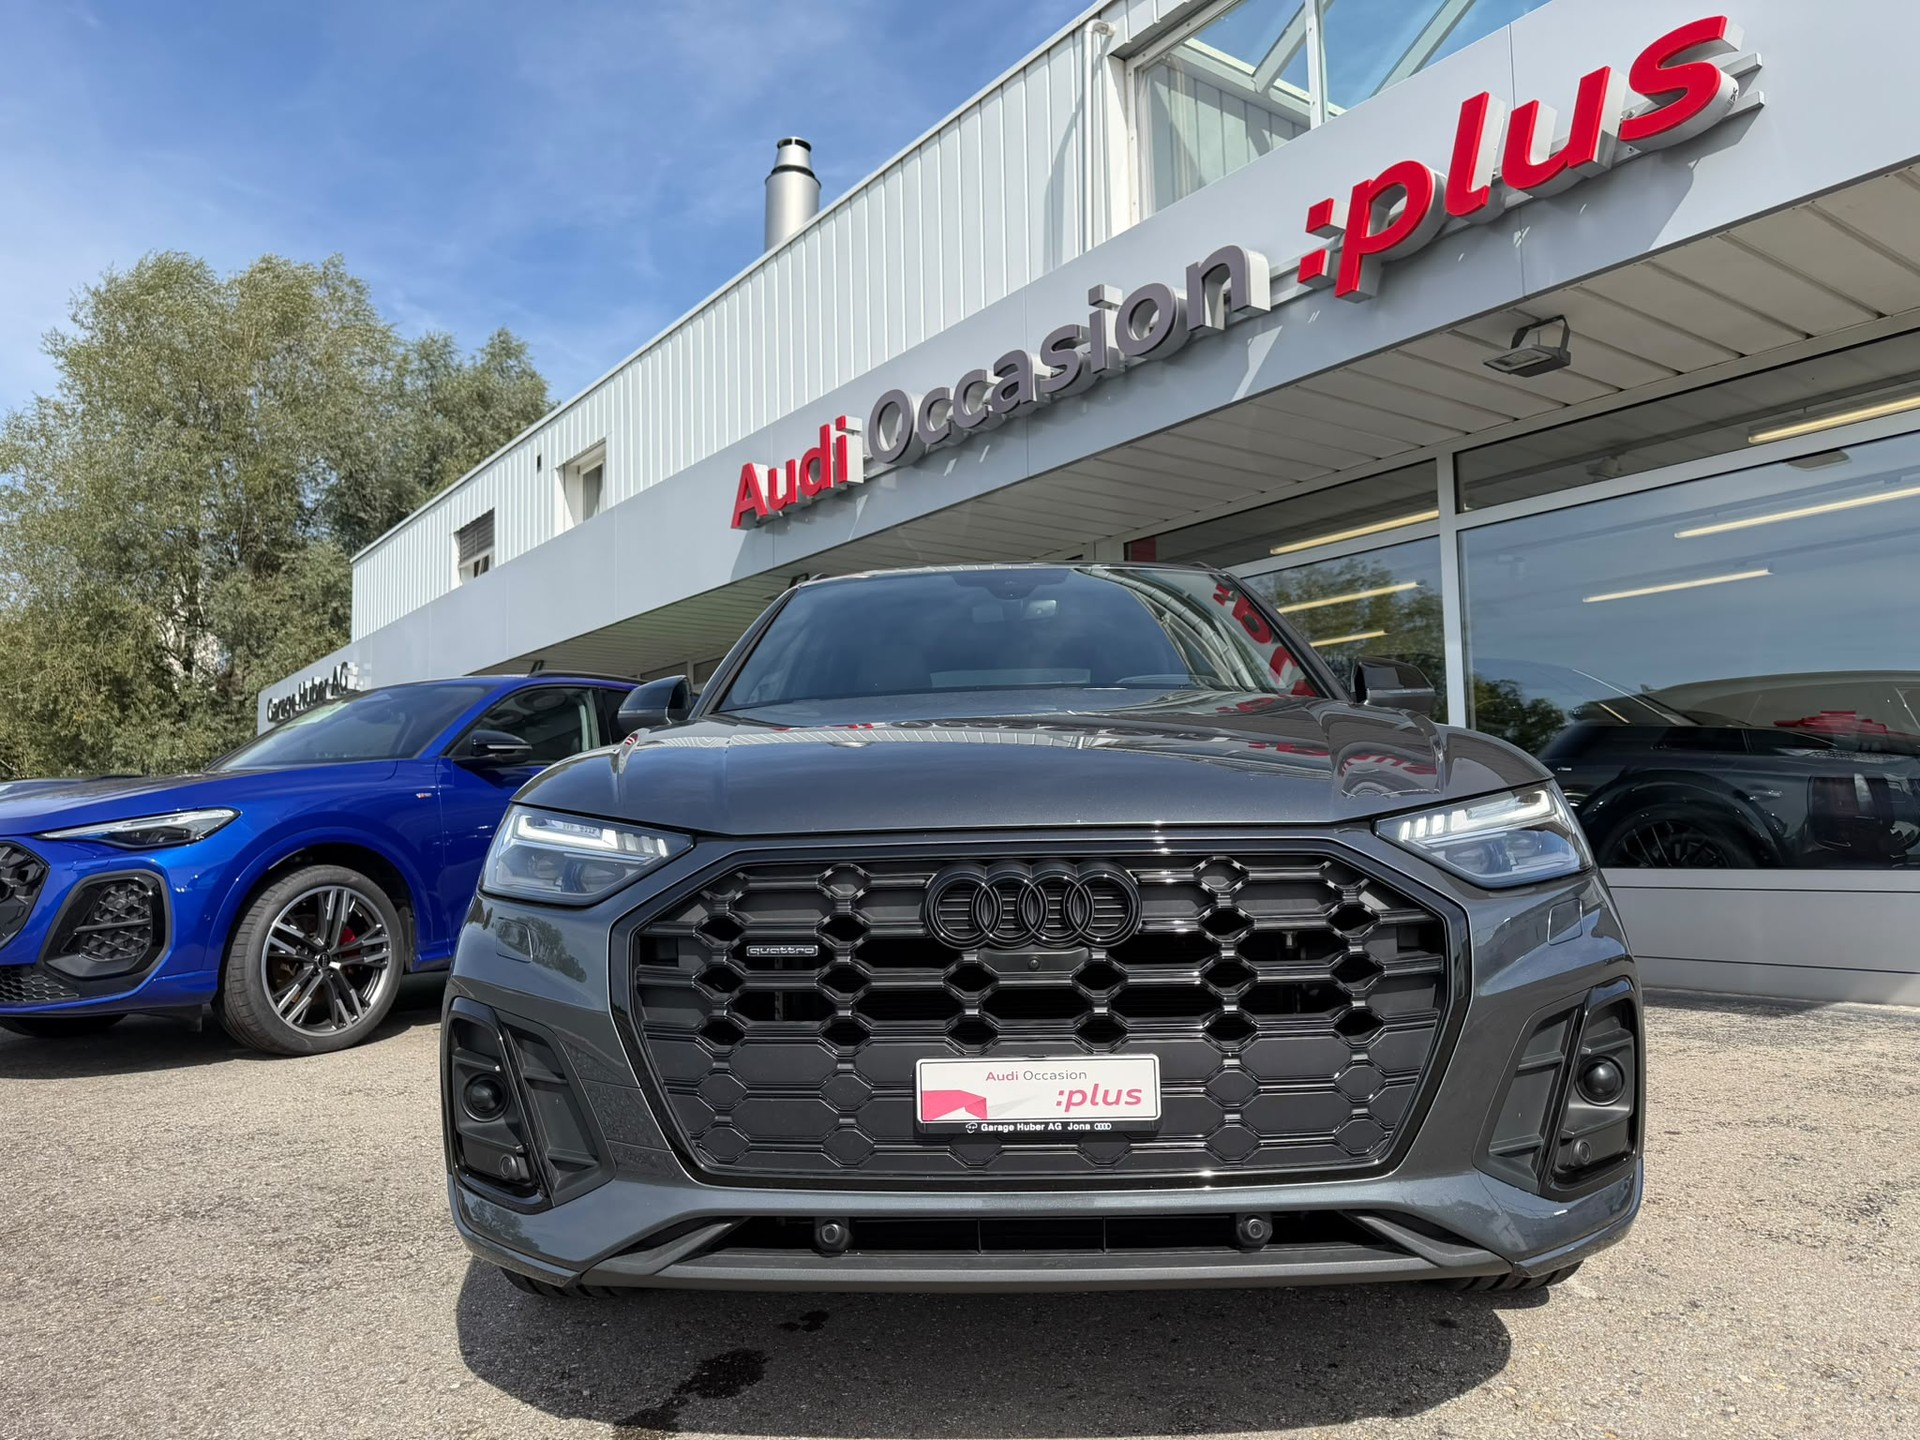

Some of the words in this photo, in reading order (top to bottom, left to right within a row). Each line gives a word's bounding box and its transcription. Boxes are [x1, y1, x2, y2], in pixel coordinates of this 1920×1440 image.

[731, 415, 862, 529] Audi
[868, 244, 1270, 465] Occasion
[1297, 15, 1744, 300] :plus
[299, 676, 329, 709] Huber
[331, 661, 350, 696] AG
[749, 947, 815, 955] quattro
[985, 1071, 1019, 1082] Audi
[1023, 1070, 1087, 1081] Occasion
[1055, 1083, 1142, 1112] :plus
[981, 1123, 1015, 1133] Garage
[1017, 1122, 1046, 1131] Huber
[1047, 1122, 1062, 1131] AG
[1067, 1122, 1091, 1131] Jona
